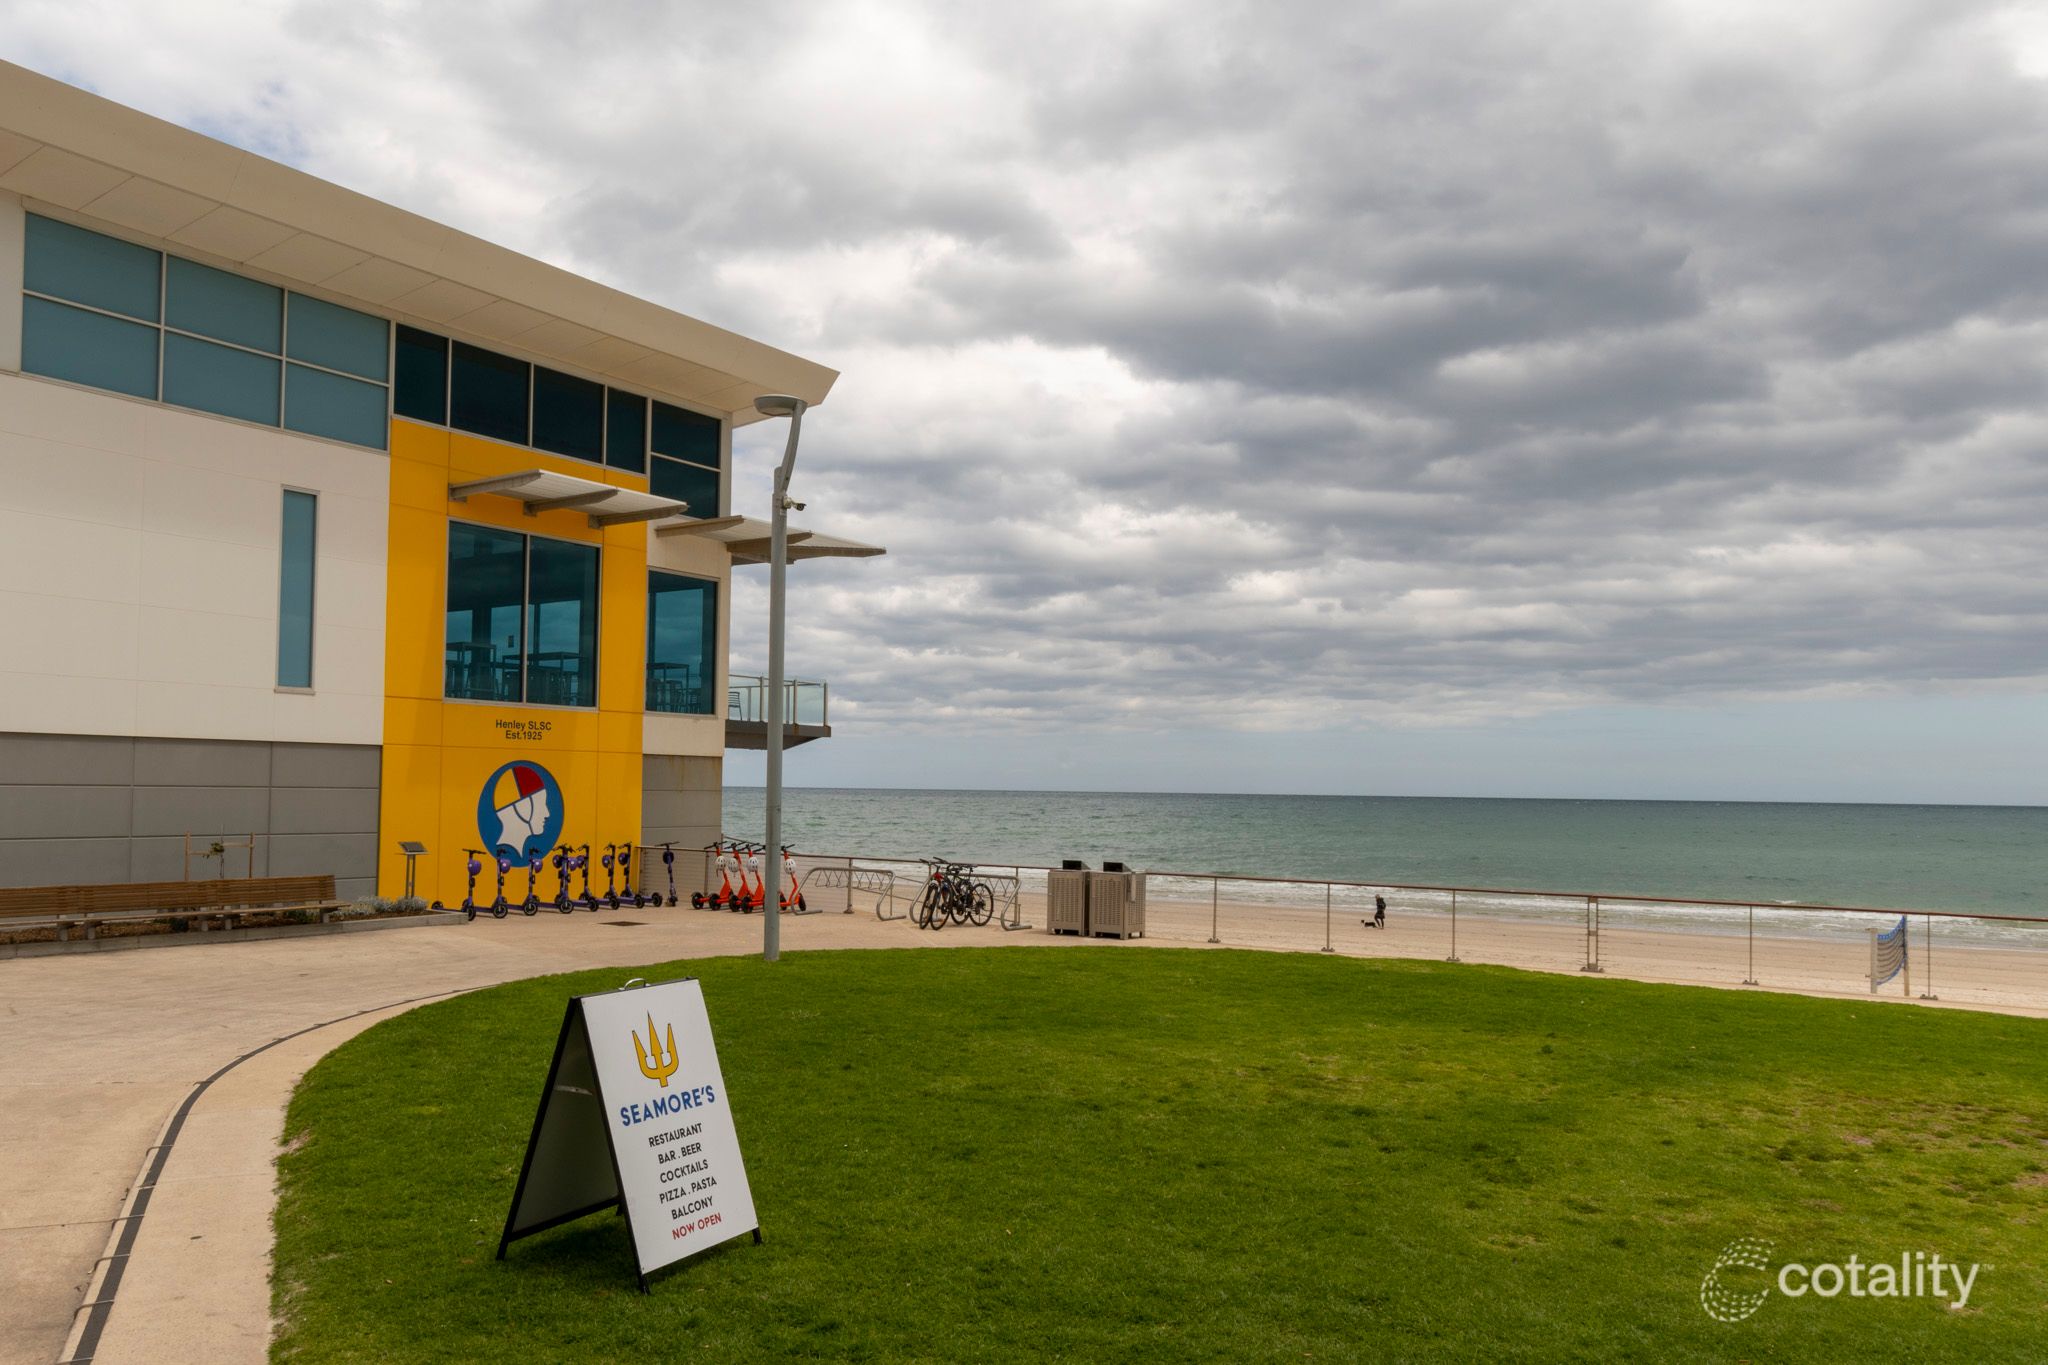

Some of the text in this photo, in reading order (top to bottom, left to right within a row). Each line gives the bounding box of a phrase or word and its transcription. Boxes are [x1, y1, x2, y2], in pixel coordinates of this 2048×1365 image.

[495, 719, 552, 731] Henley SLSC
[505, 730, 542, 740] Est.1925
[620, 1085, 716, 1127] SEAMORE'S
[648, 1123, 703, 1148] RESTAURANT
[658, 1150, 676, 1165] BAR
[681, 1142, 702, 1158] BEER
[660, 1159, 709, 1184] COCKTAILS
[659, 1187, 687, 1205] PIZZA
[691, 1176, 717, 1194] PASTA
[671, 1196, 714, 1220] BALCONY
[672, 1212, 722, 1240] NOW OPEN
